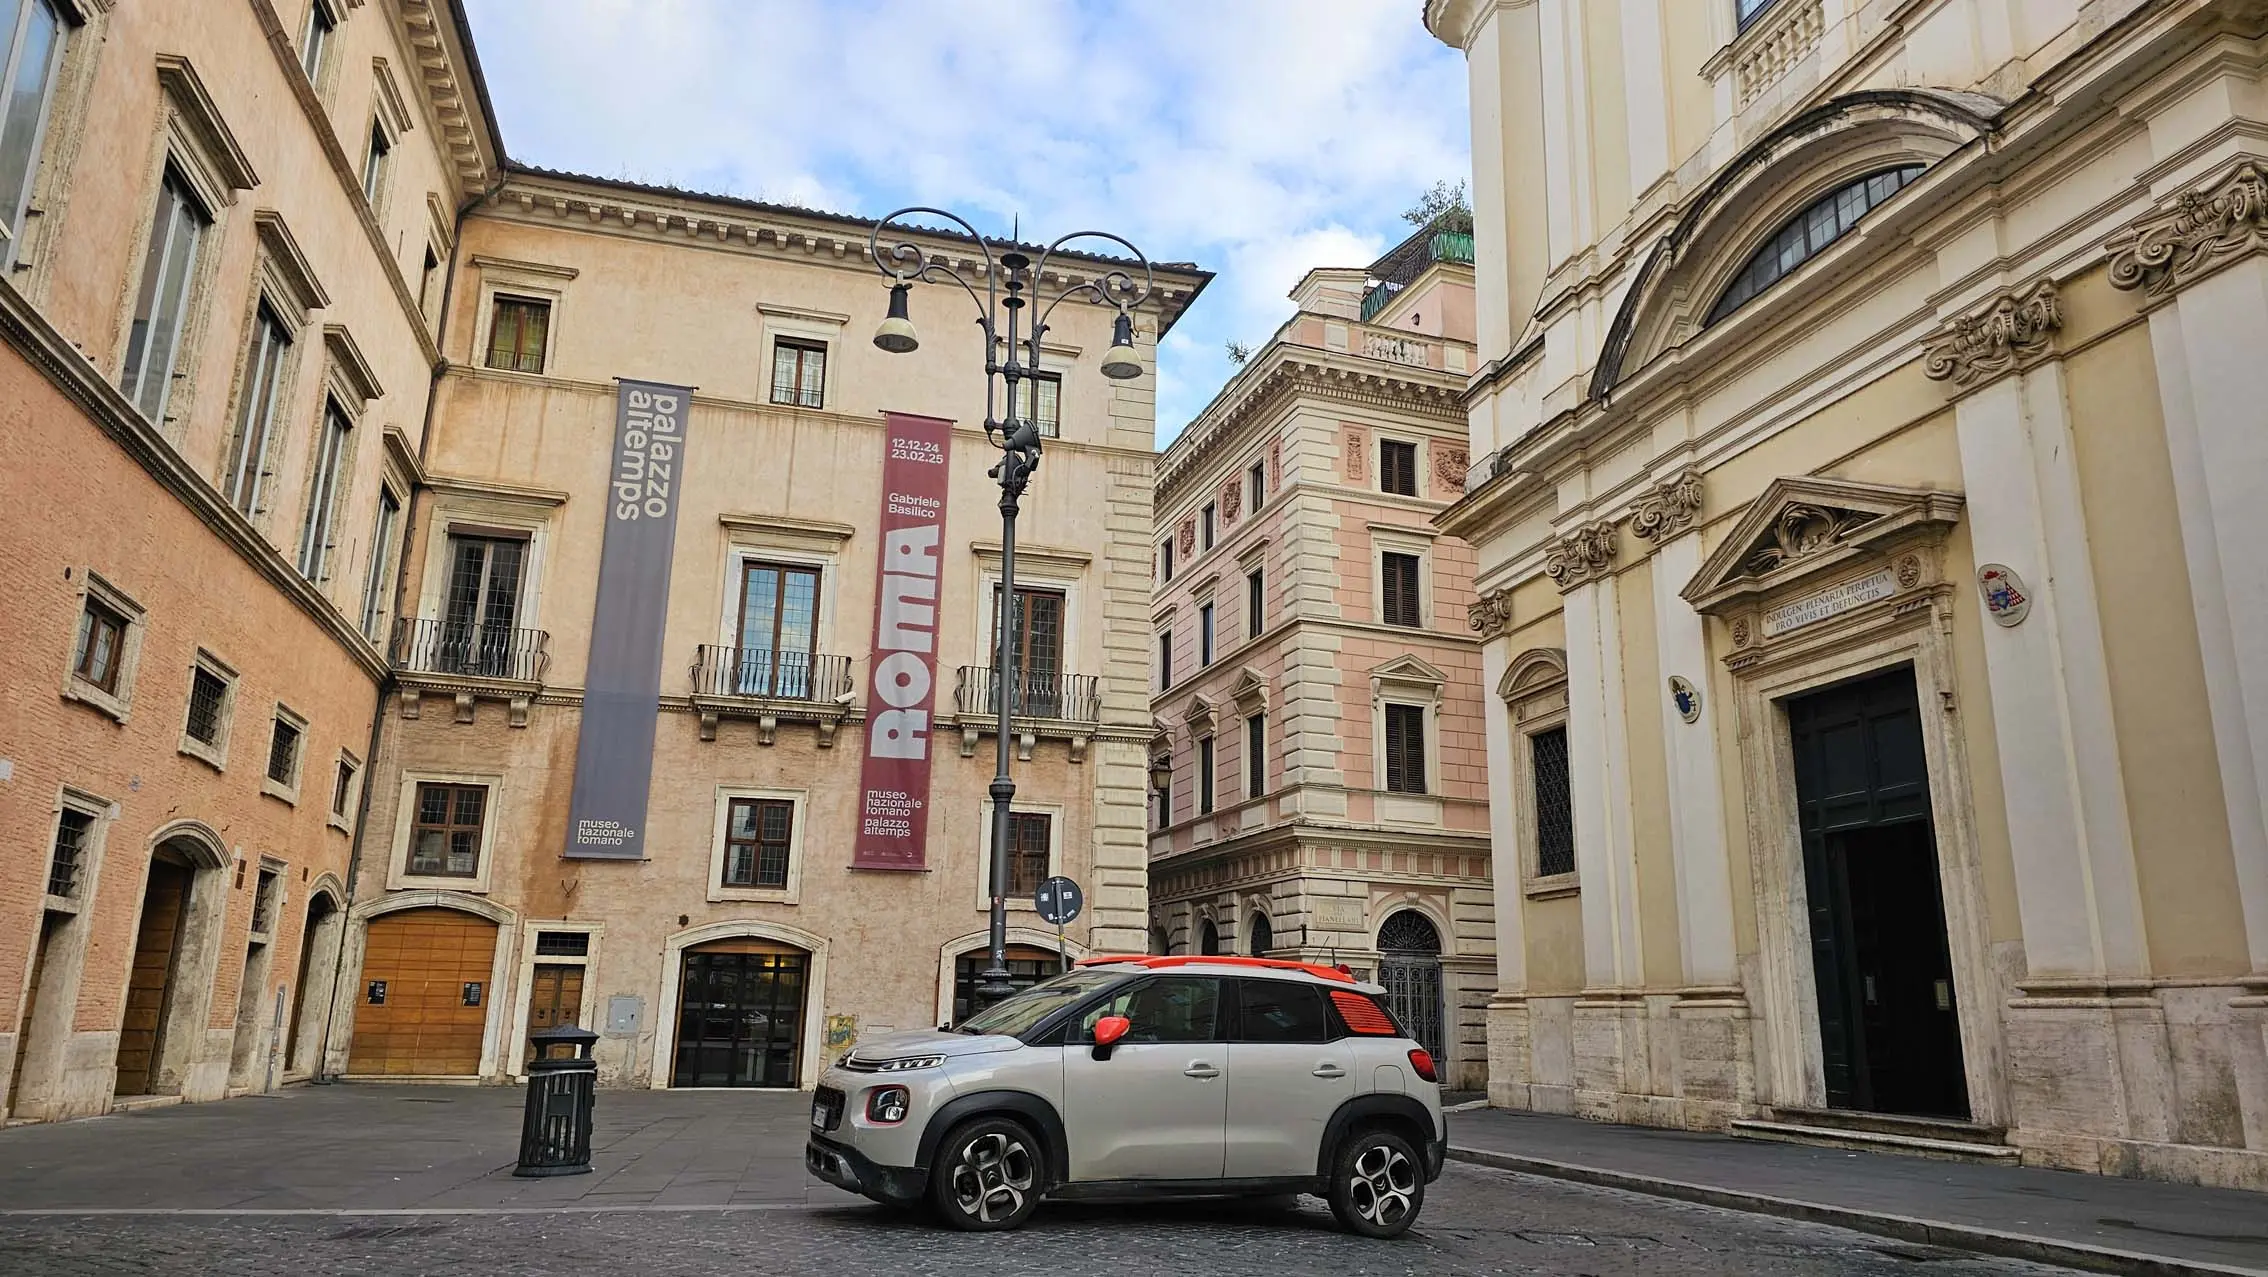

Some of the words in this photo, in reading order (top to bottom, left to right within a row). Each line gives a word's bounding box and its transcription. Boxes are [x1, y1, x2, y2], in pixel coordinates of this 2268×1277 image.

[892, 438, 940, 453] 12.12.24
[613, 390, 653, 520] altemps
[644, 393, 682, 518] palazzo
[891, 449, 944, 464] 23.02.25
[889, 493, 940, 508] Gabriele
[888, 503, 935, 518] Basilico
[1806, 590, 1844, 610] PLENARIA
[1847, 574, 1888, 596] PERPETUA
[1775, 618, 1793, 630] PRO
[1795, 610, 1817, 623] VIVIS
[1820, 605, 1830, 617] ET
[1833, 587, 1880, 611] DEFUNCTIS
[870, 524, 939, 760] ROMA
[867, 790, 907, 800] museo
[867, 798, 922, 808] nazionale
[866, 806, 911, 816] romano
[579, 820, 619, 829] museo
[865, 816, 910, 828] palazzo
[578, 827, 634, 838] nazionale
[864, 826, 911, 838] altemps
[577, 836, 623, 846] romano
